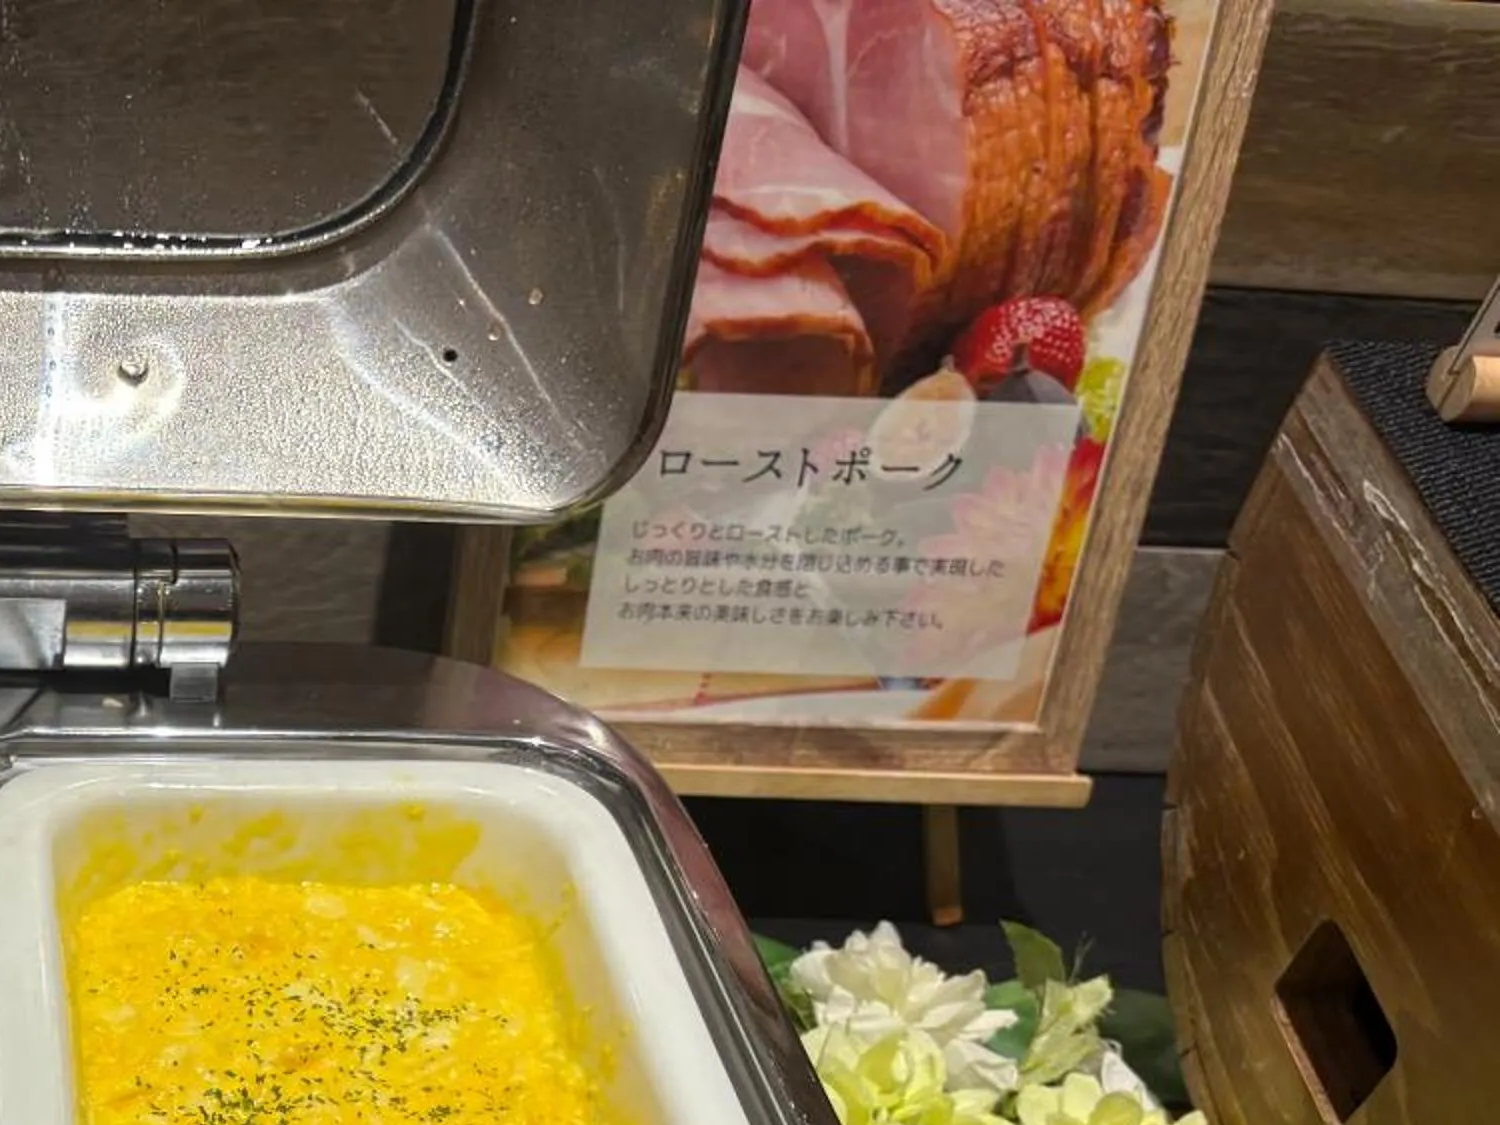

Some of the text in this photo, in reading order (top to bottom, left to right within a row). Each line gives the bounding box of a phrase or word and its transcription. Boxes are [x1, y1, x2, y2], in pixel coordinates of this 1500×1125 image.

[659, 447, 963, 491] ローストポーク
